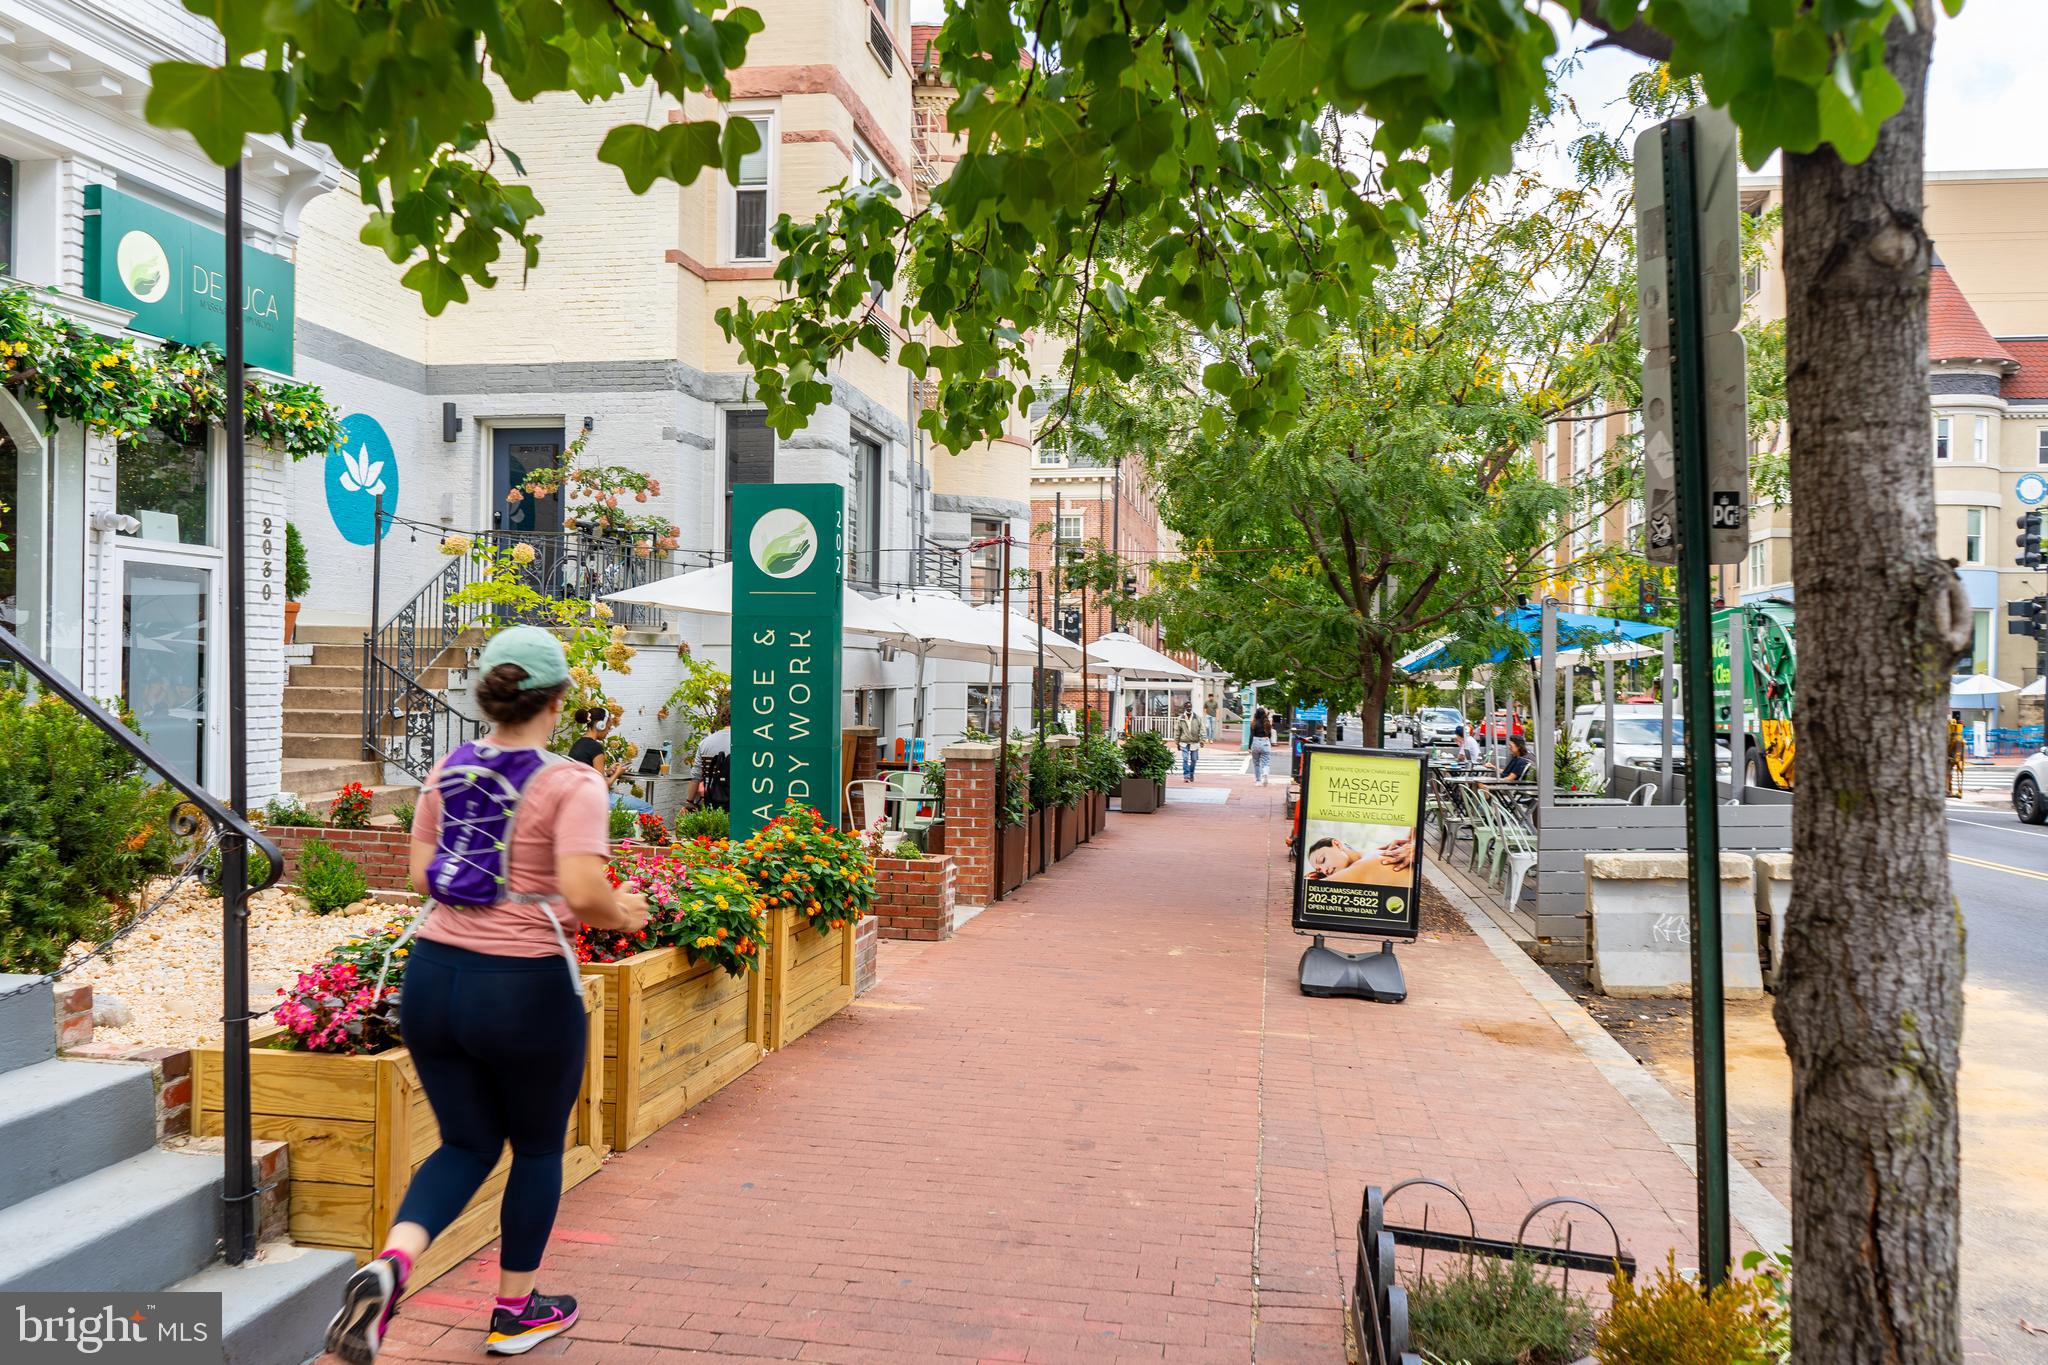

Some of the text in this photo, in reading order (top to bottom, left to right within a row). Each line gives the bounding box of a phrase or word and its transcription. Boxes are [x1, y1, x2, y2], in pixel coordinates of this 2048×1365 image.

[193, 265, 279, 321] DEUCA
[262, 517, 272, 601] 2030
[752, 629, 775, 821] ASSAGE &
[1329, 777, 1400, 793] MASSAGE
[1328, 790, 1399, 806] THERAPY
[1320, 809, 1406, 822] WALK-INS WELCOME
[1308, 885, 1379, 897] DELUCAMASSAGE.COM
[1308, 893, 1379, 908] 202-872-5822
